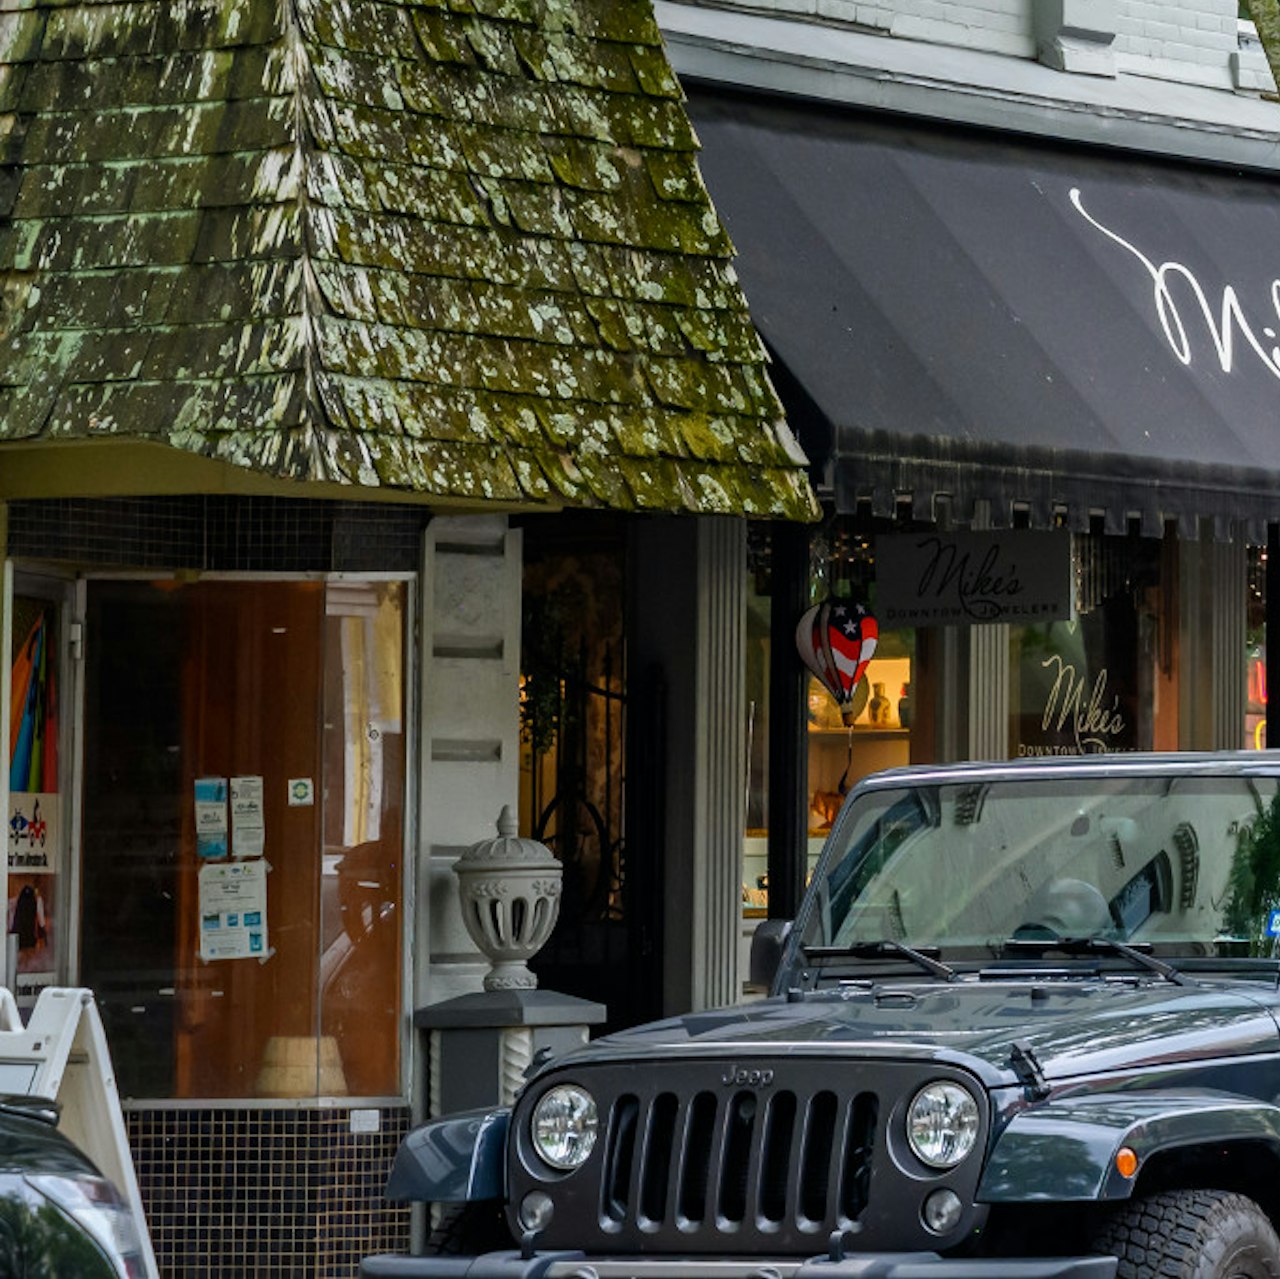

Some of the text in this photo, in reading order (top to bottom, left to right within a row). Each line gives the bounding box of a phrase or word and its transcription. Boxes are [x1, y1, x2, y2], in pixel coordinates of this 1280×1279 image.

[916, 537, 1024, 619] Mike's
[1041, 654, 1126, 754] Mike's
[721, 1064, 774, 1088] Jeep
